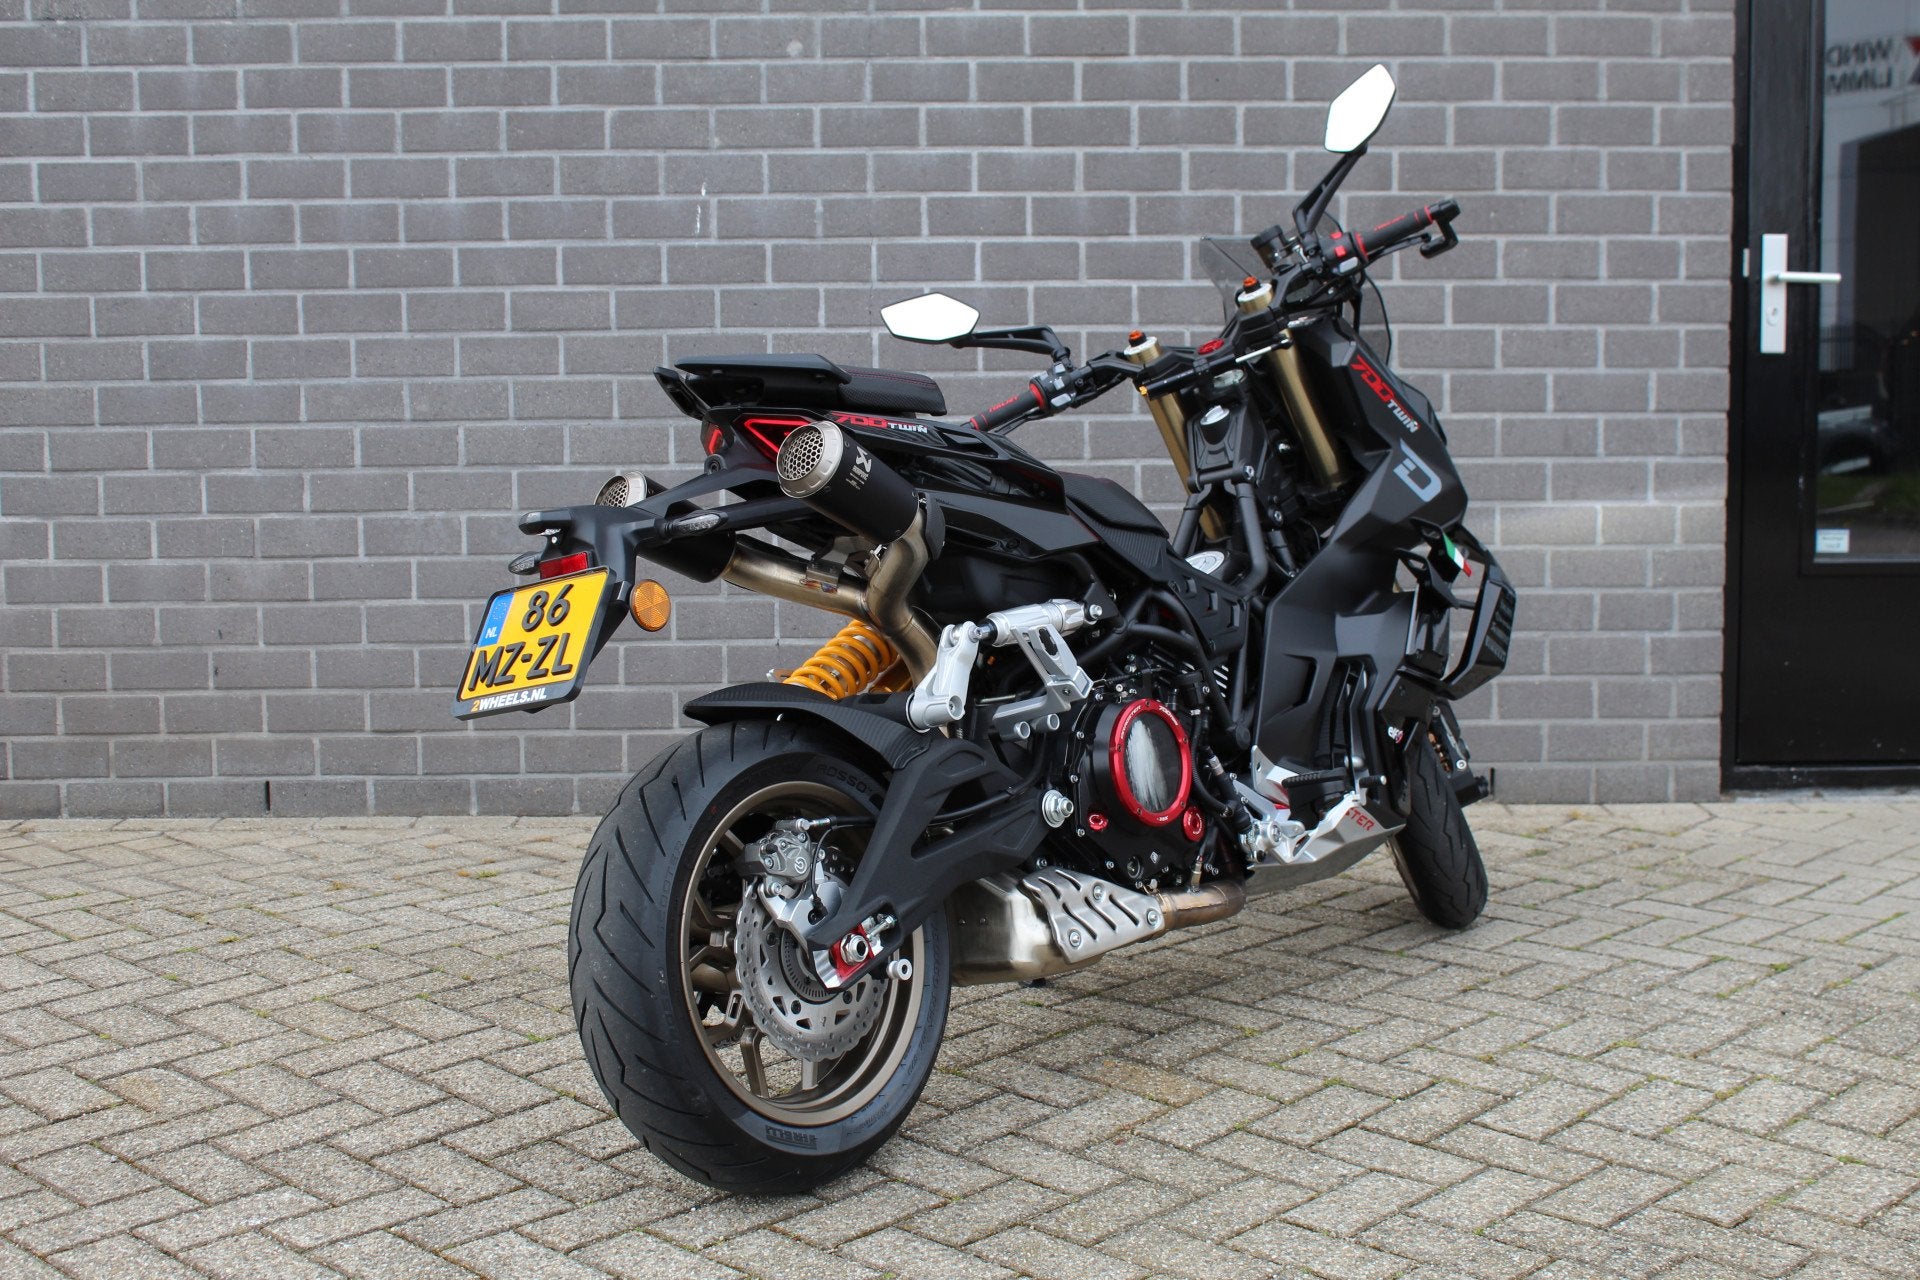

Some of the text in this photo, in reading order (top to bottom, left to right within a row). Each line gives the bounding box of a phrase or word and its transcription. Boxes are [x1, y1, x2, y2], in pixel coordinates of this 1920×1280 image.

[1351, 354, 1421, 434] 700 TWIN
[831, 411, 928, 434] 700 TWIN
[521, 583, 574, 632] 86
[485, 626, 498, 639] NL
[468, 632, 573, 692] MZ-ZL
[470, 687, 547, 713] 2WHEELS.NL
[815, 763, 867, 793] ROSSO
